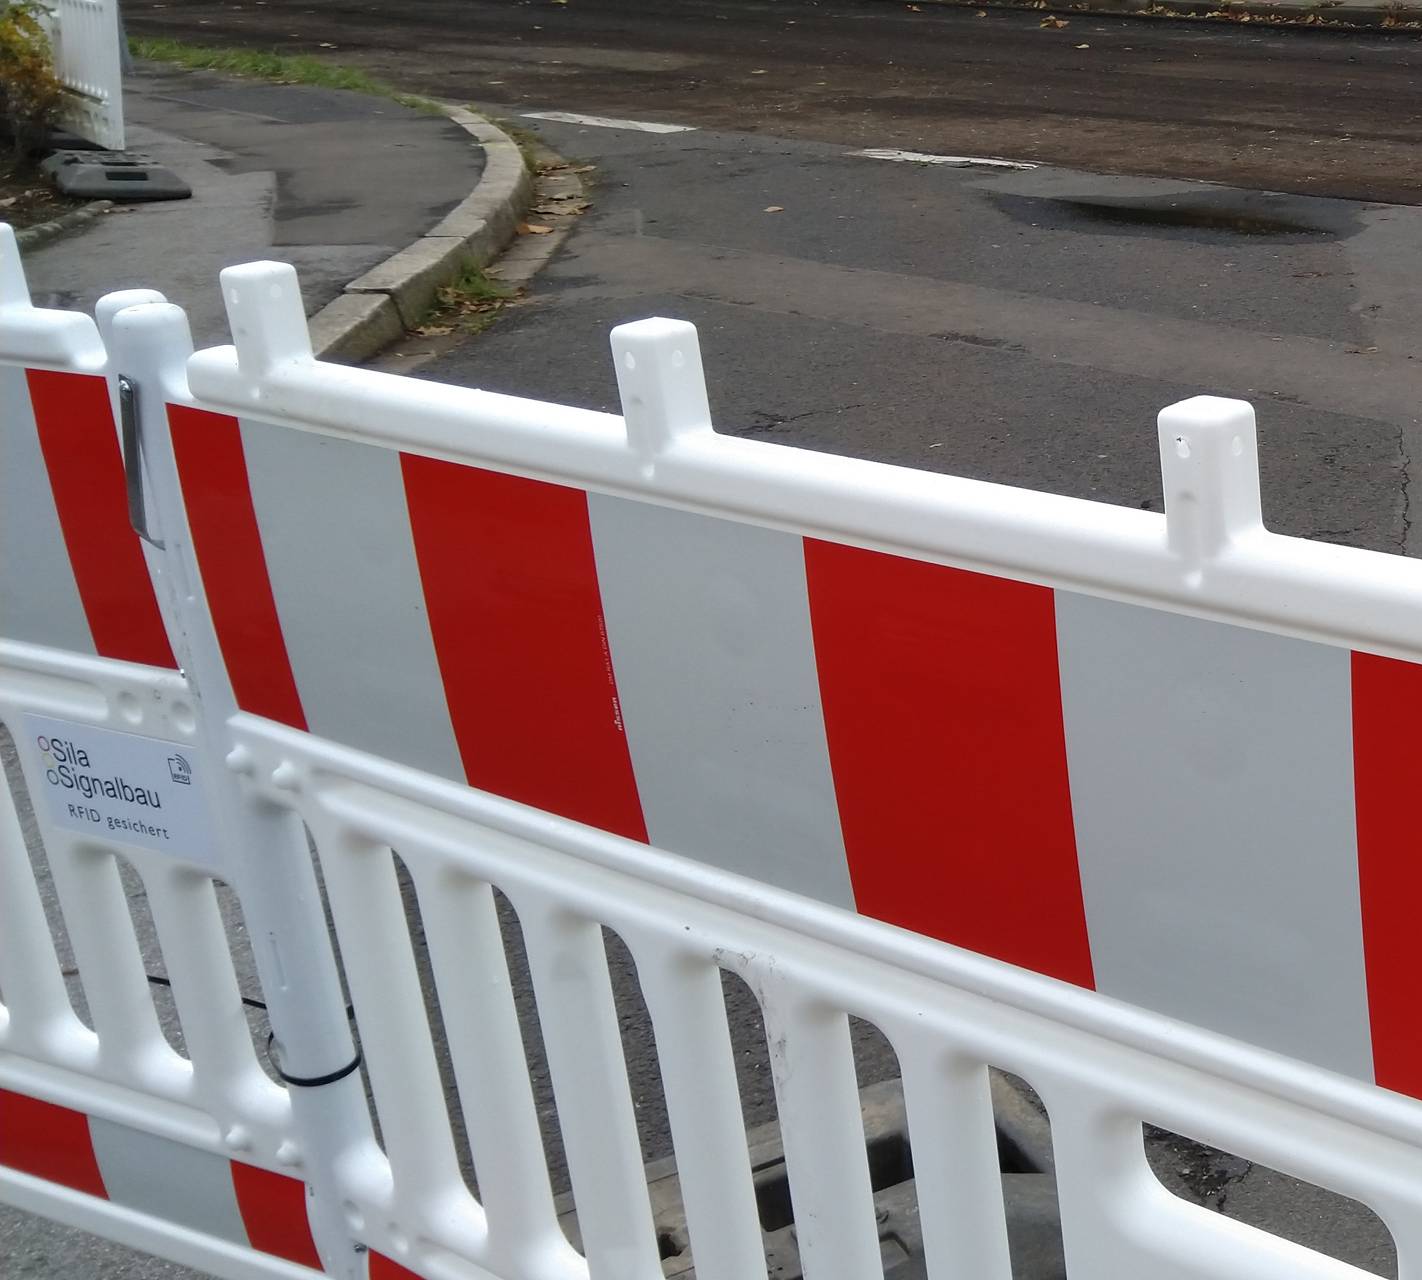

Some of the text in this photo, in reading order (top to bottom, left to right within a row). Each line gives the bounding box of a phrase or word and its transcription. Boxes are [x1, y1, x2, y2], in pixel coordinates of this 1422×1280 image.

[50, 738, 91, 768] Sila
[58, 765, 162, 809] Signalbau
[68, 804, 170, 840] RFID gesichert
